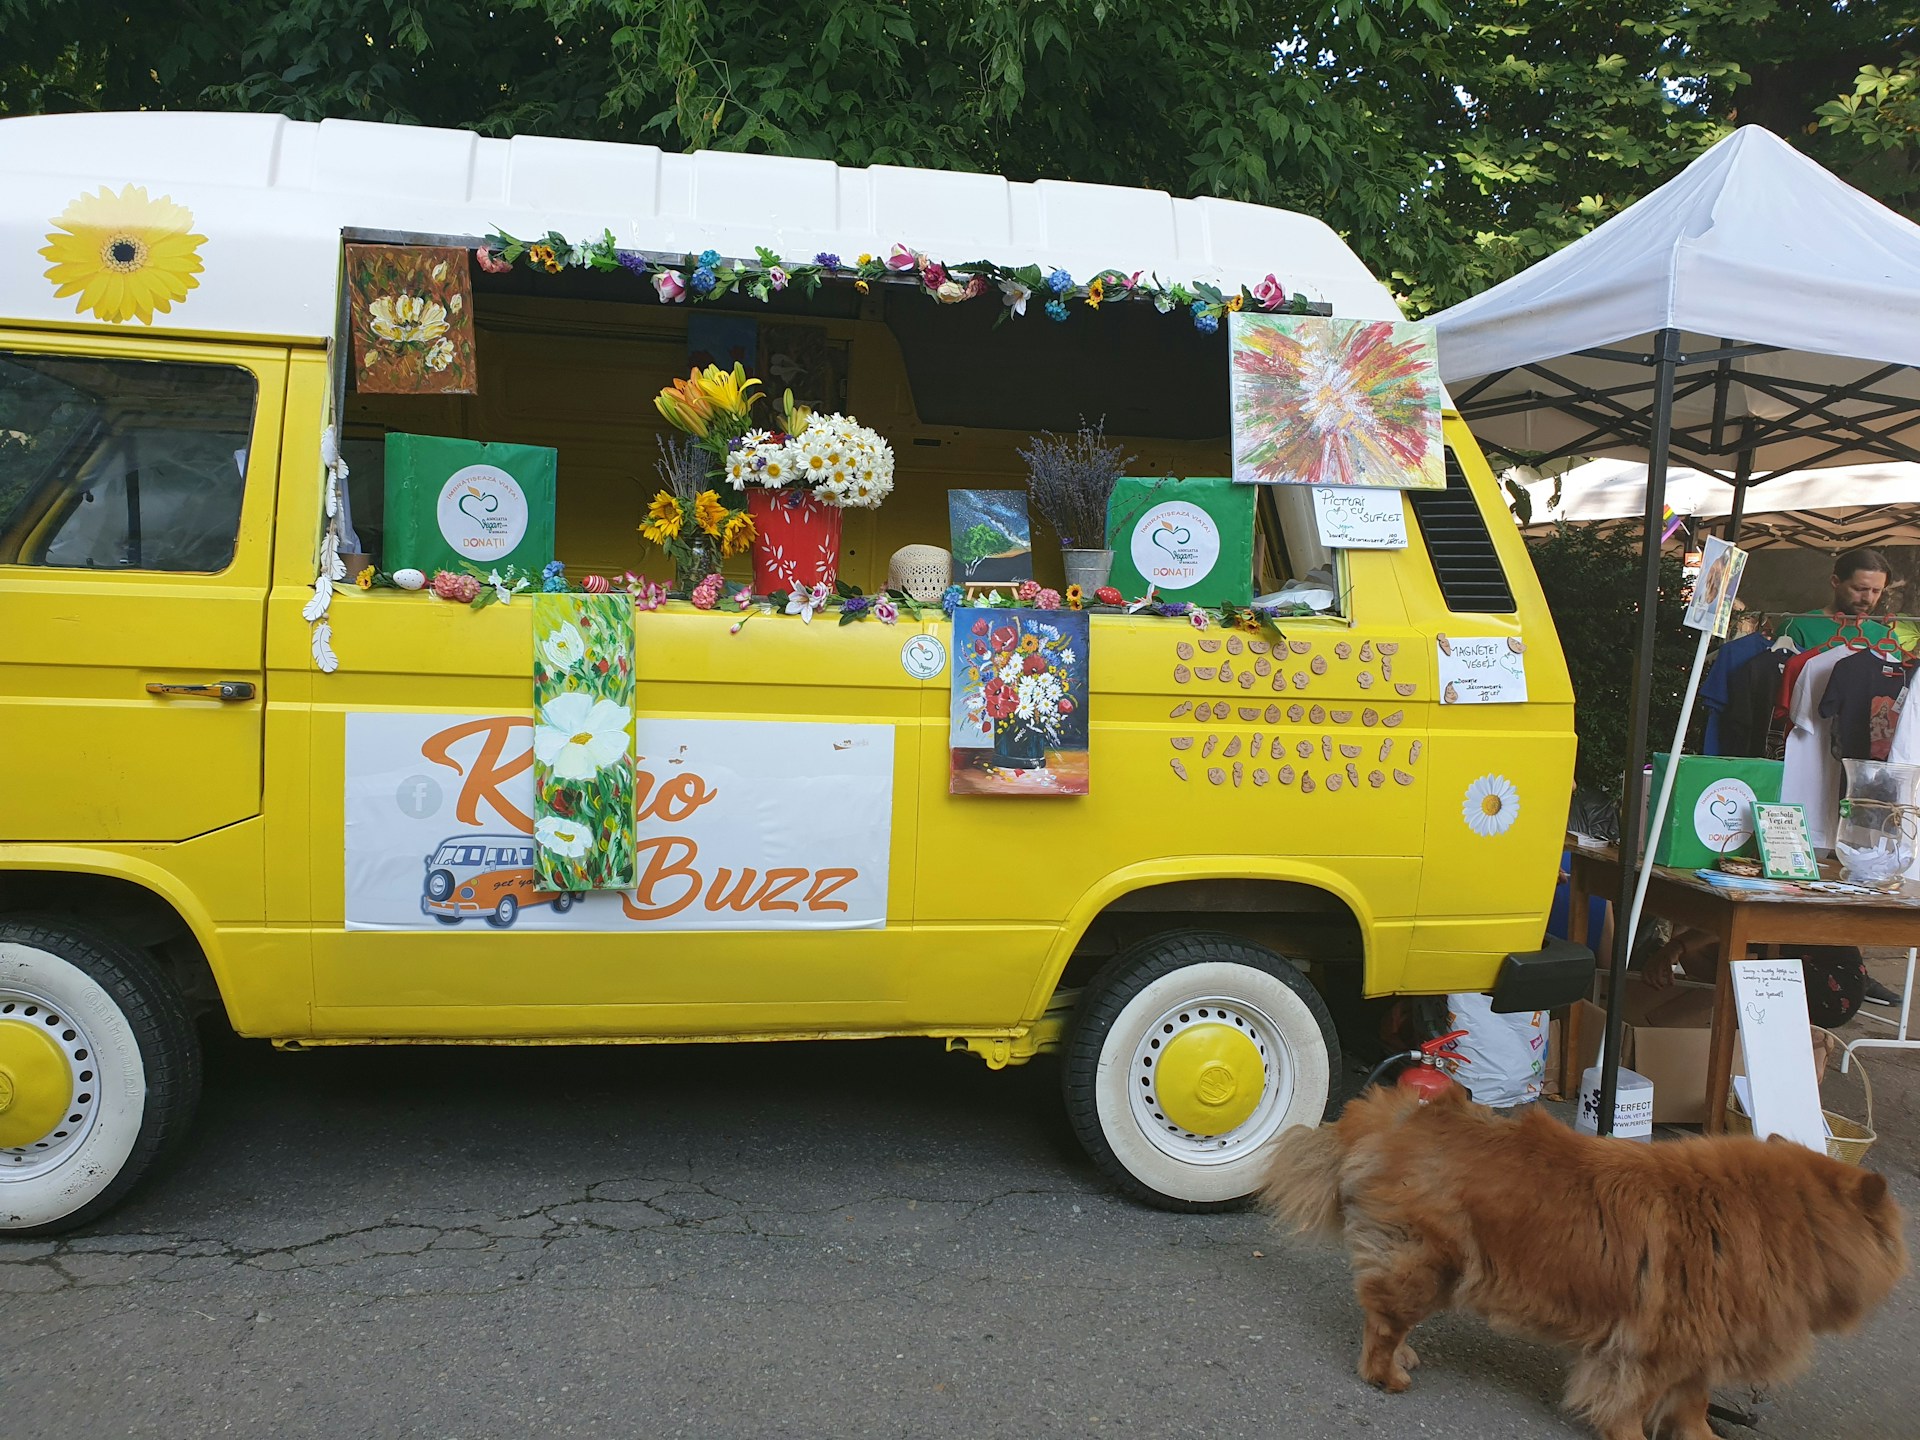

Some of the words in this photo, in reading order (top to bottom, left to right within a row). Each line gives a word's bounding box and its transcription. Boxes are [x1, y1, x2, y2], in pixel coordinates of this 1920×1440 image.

[616, 836, 859, 920] Buzz
[493, 879, 514, 891] get
[1614, 1101, 1651, 1112] PERFECT
